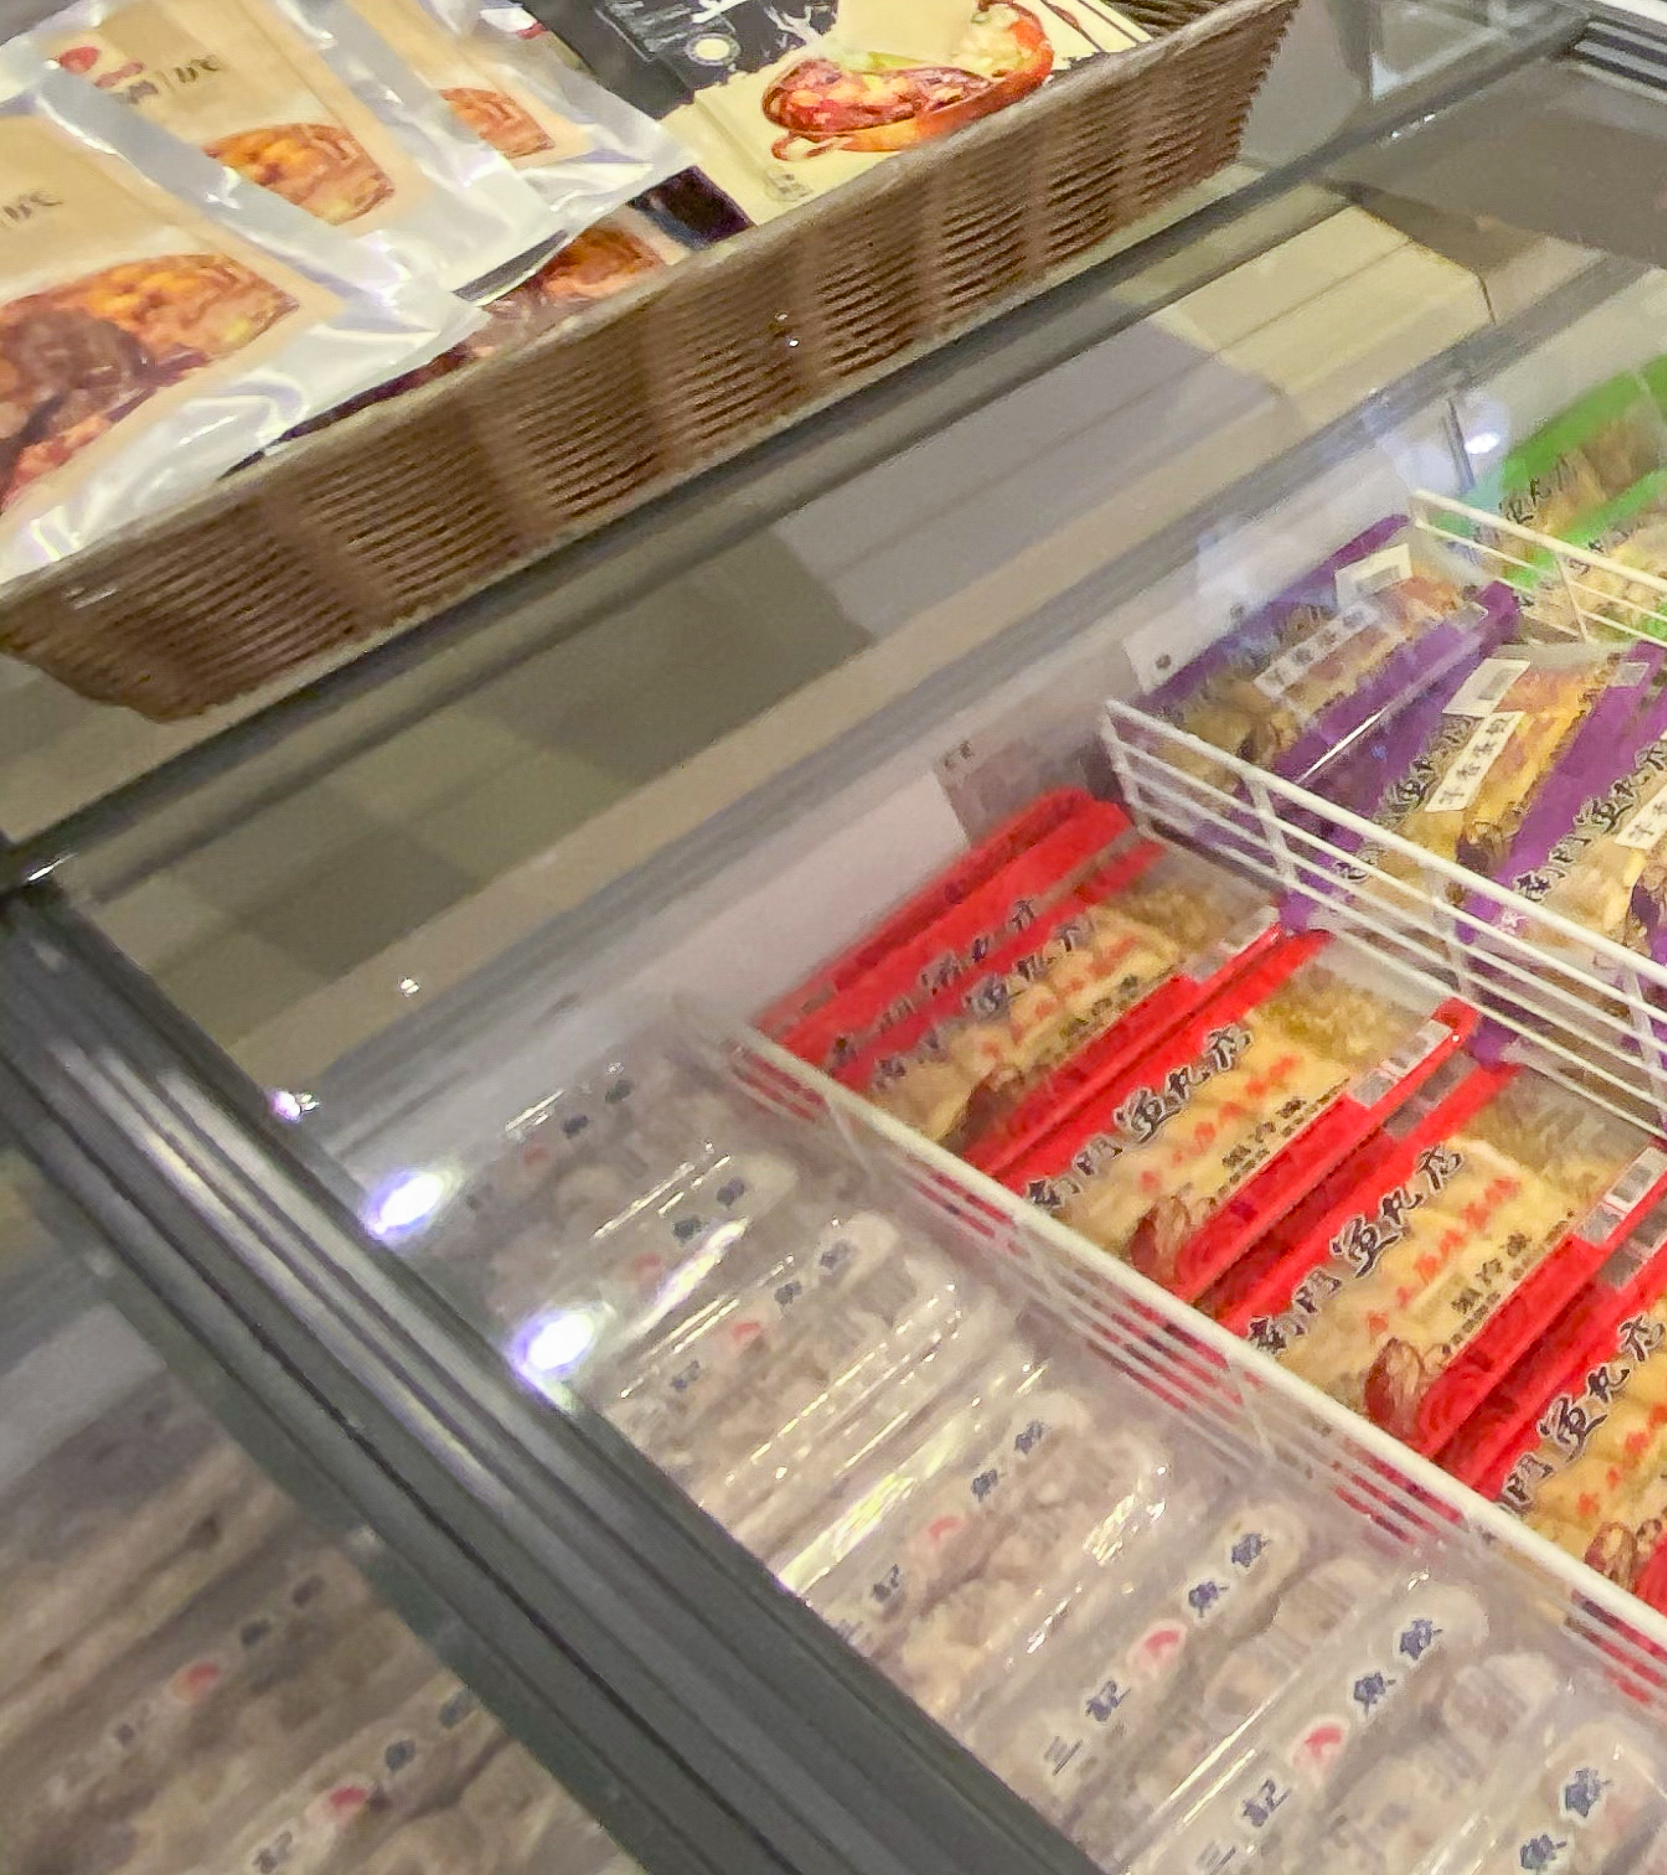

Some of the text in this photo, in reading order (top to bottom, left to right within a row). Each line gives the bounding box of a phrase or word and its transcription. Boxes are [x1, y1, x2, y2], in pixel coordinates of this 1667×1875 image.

[1246, 1137, 1467, 1357] 南門魚丸店
